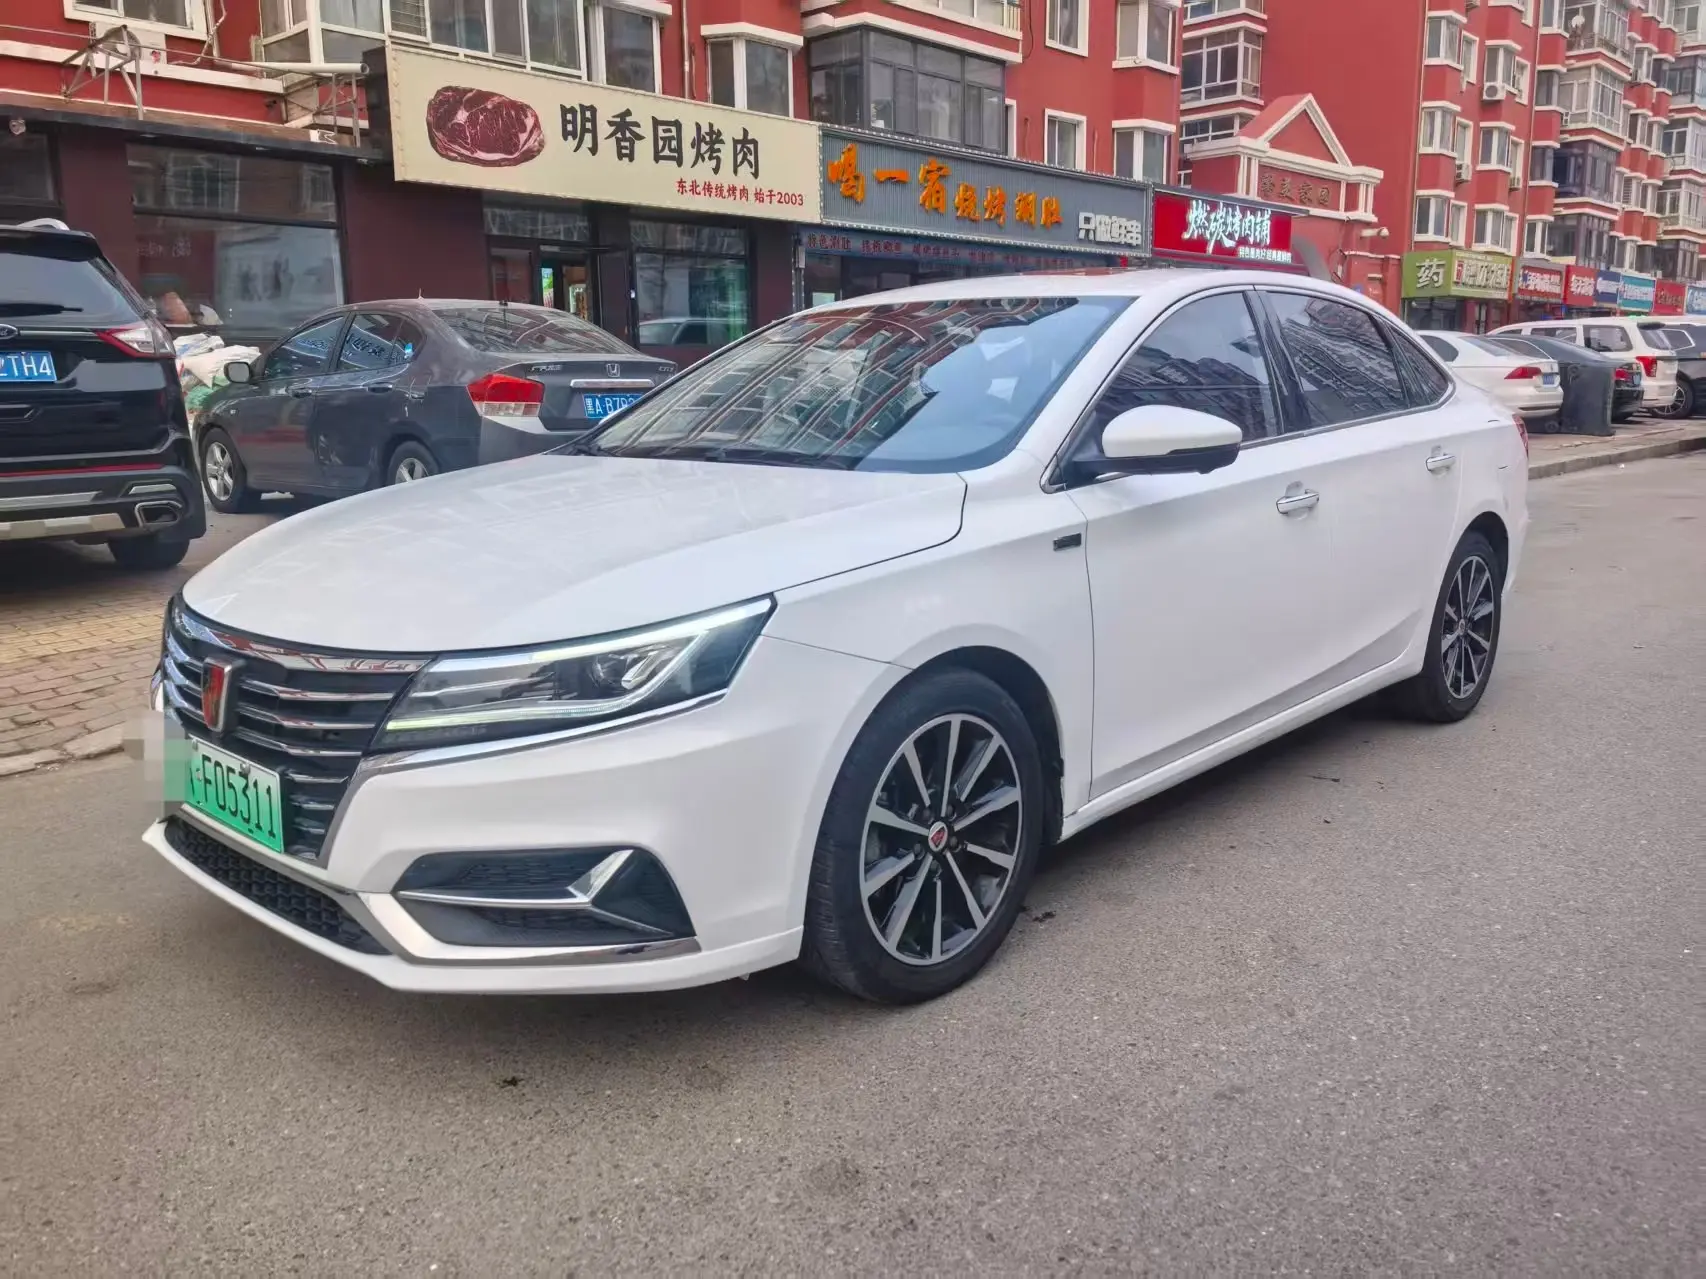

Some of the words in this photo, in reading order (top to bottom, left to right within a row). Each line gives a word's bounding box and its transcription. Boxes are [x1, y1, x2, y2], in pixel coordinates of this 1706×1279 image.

[559, 103, 761, 180] 明香园烤肉
[676, 178, 749, 202] 东北传统烤肉
[754, 188, 804, 207] 始于2003
[1416, 258, 1446, 288] 药
[190, 754, 276, 839] F05311
